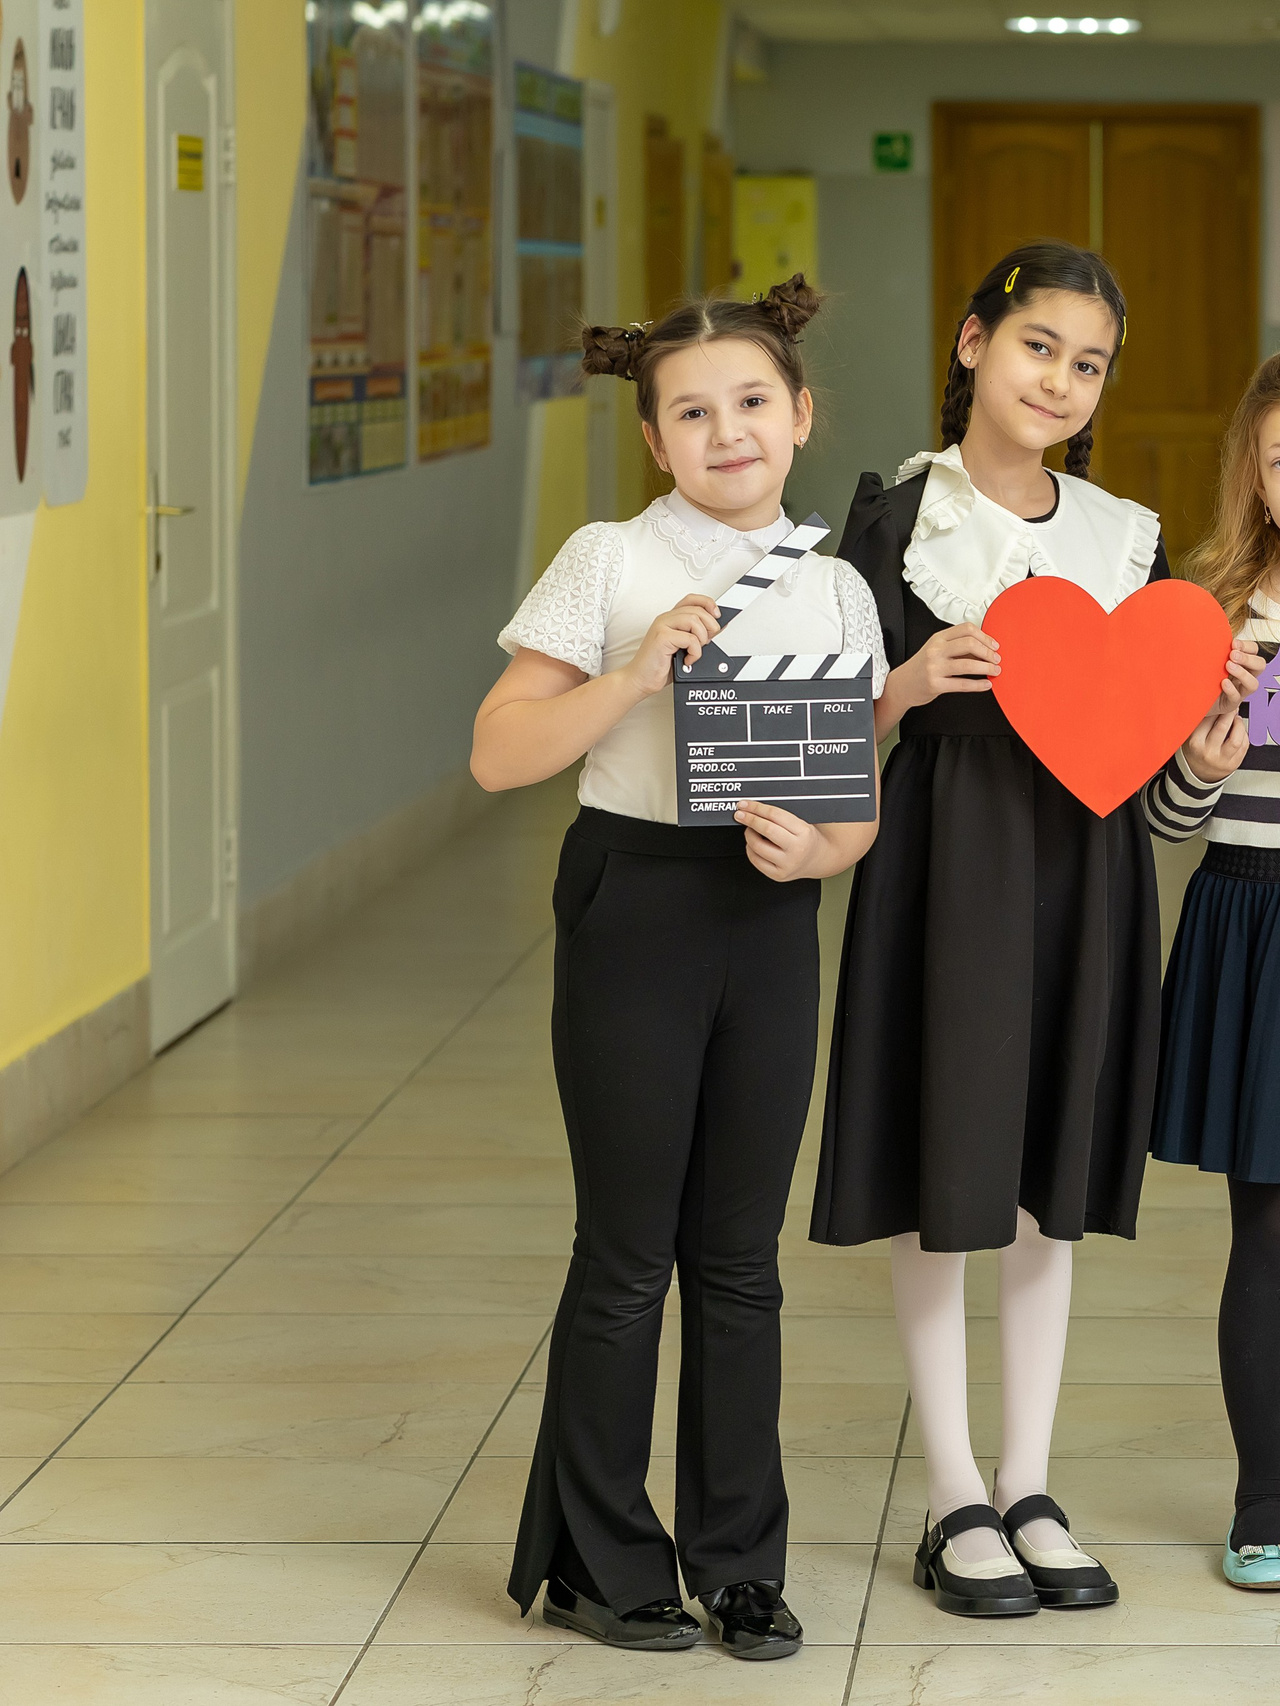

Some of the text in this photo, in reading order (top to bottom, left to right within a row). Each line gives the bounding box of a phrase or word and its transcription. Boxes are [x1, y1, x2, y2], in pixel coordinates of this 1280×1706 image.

[688, 689, 738, 701] PROD.NO.
[697, 703, 854, 716] SCENE TAKE ROLL
[689, 747, 715, 756] DATE
[807, 743, 849, 755] SOUND
[690, 762, 738, 773] PROD.CO.
[690, 782, 742, 793] DIRECTOR
